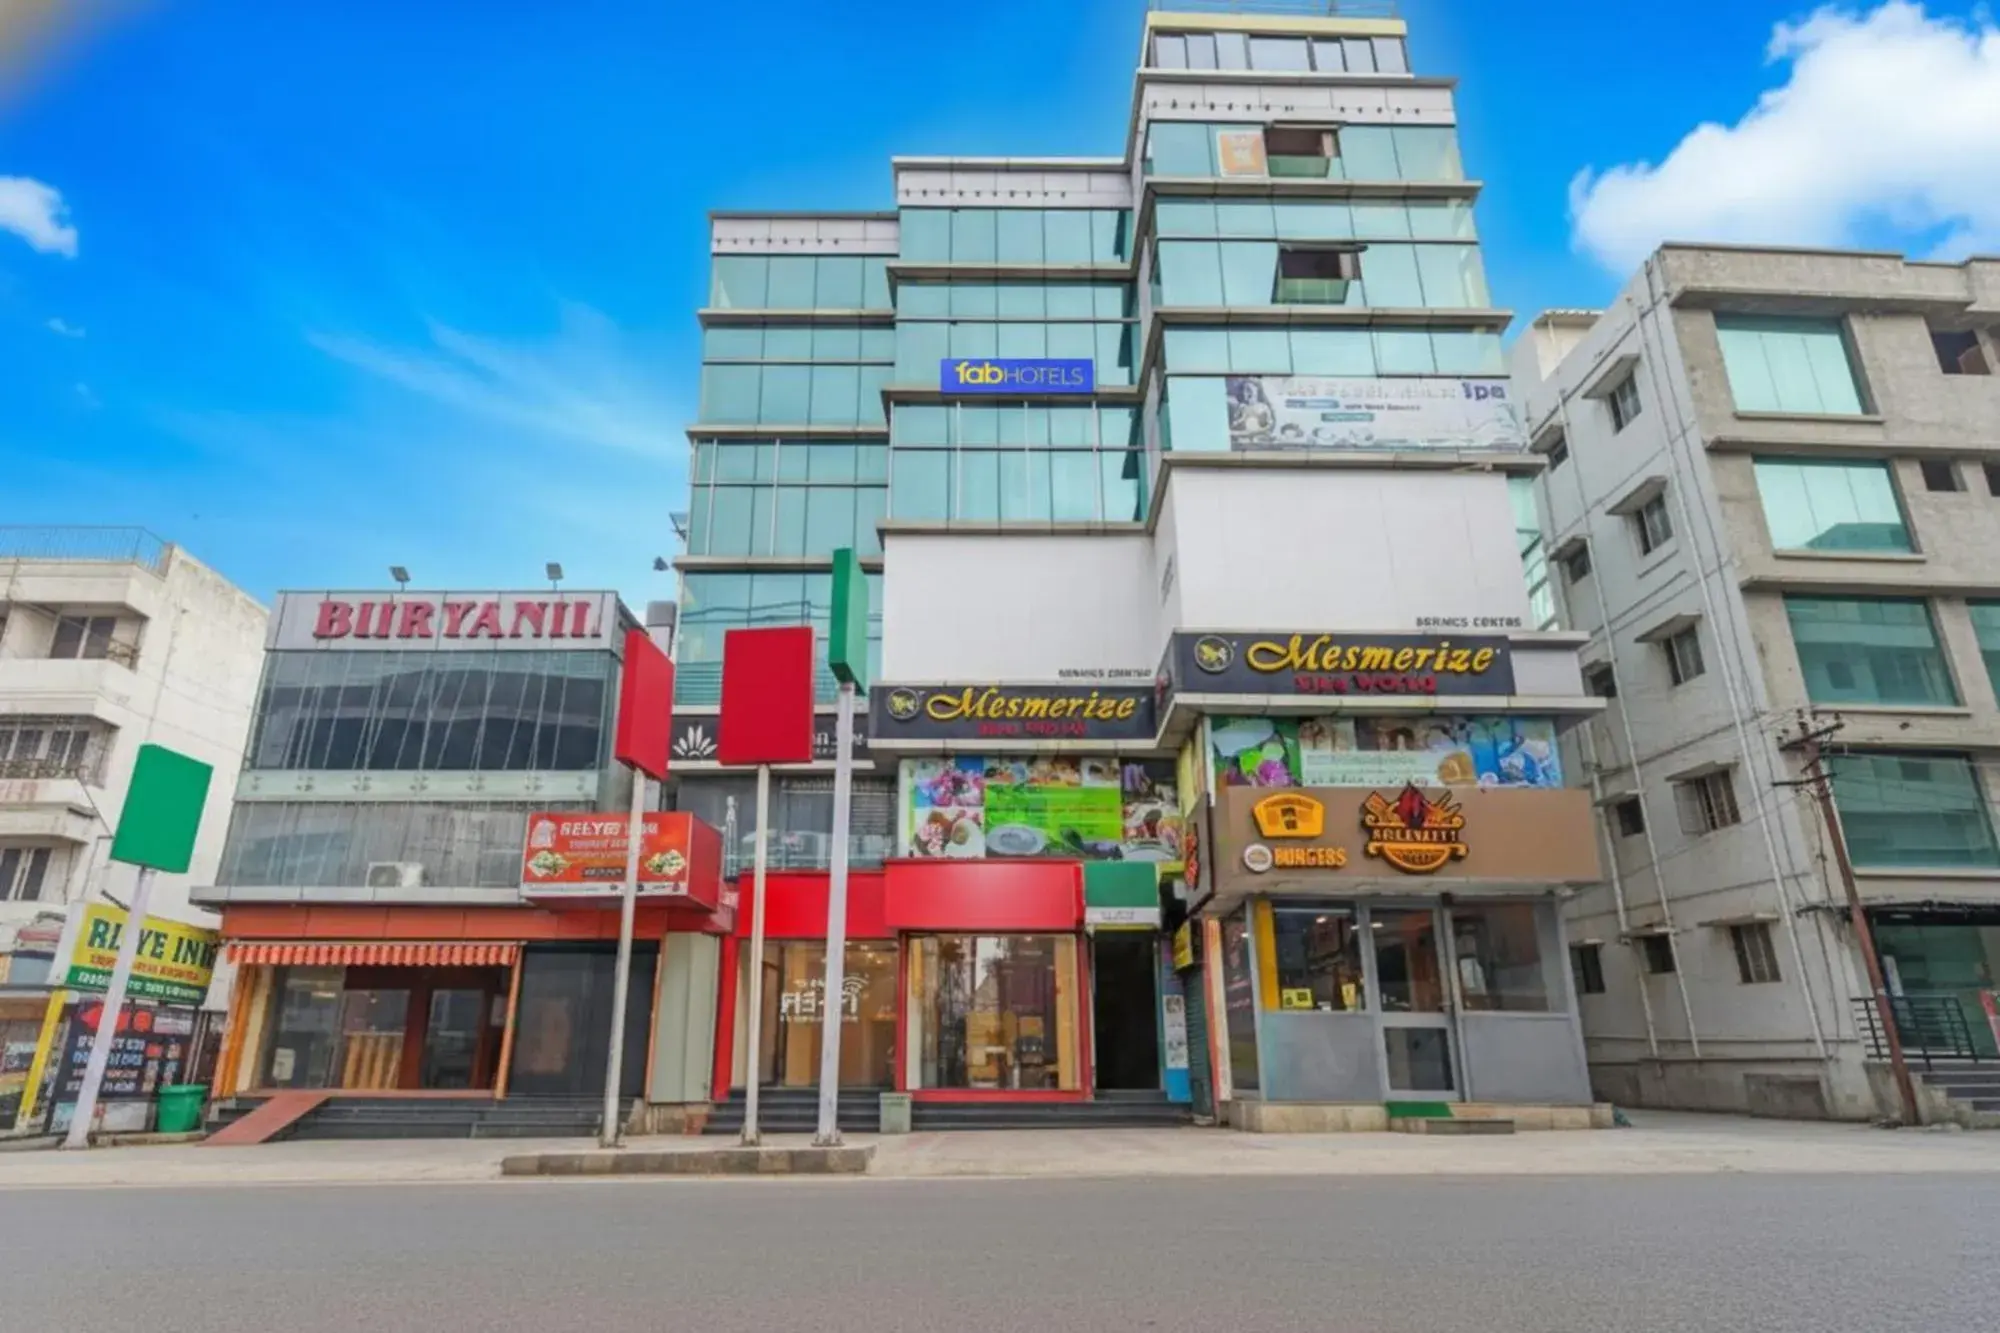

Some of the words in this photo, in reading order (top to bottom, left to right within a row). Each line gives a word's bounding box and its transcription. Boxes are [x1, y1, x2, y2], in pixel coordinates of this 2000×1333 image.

[954, 361, 1084, 385] fabHOTELS
[1245, 632, 1494, 674] Mesmerize
[926, 686, 1137, 720] Mesmerize
